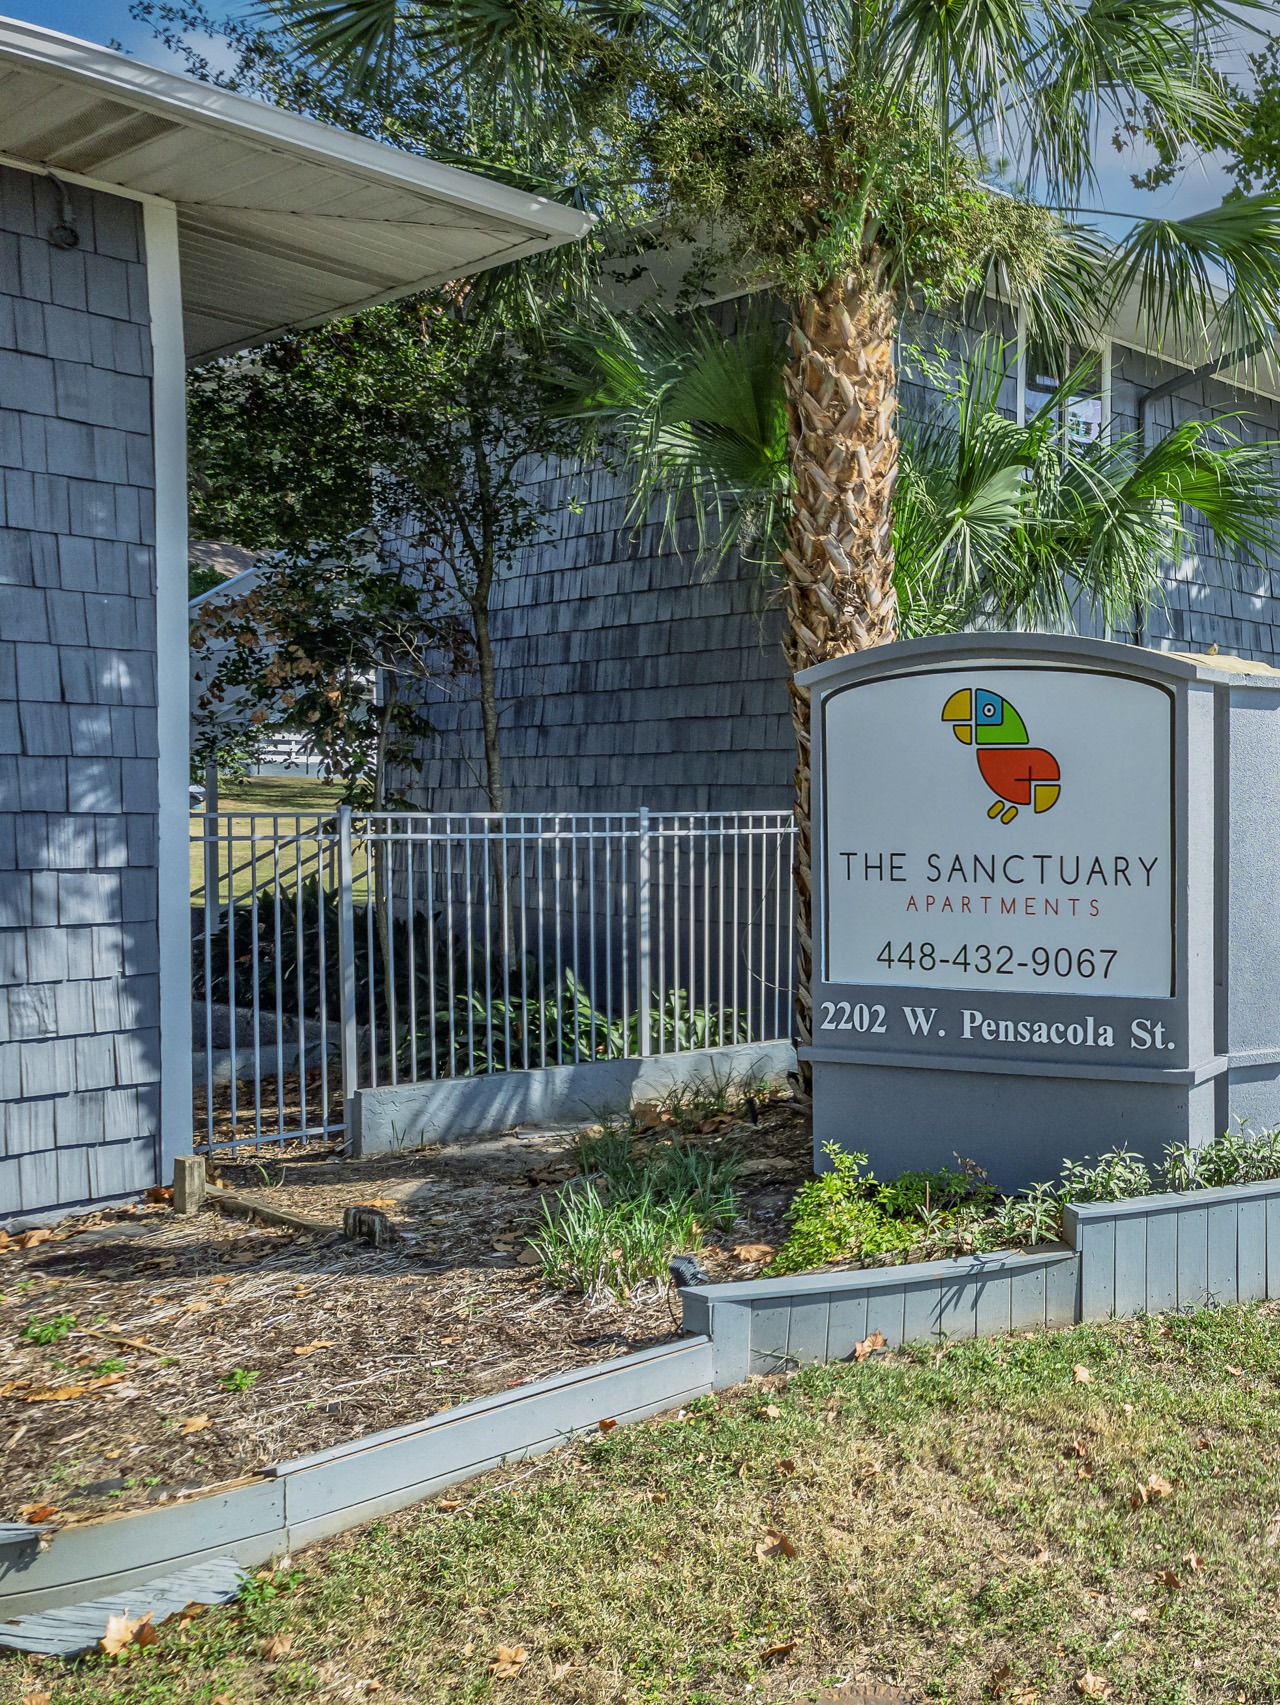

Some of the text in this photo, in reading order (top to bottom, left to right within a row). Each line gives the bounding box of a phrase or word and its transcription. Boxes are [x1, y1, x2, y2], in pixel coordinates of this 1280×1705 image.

[839, 853, 1159, 887] THE SANCTUARY
[906, 895, 1099, 917] APARTMENTS
[877, 940, 1119, 979] 448-432-9067
[820, 1001, 1176, 1050] 2202 W. Pensacola St.
